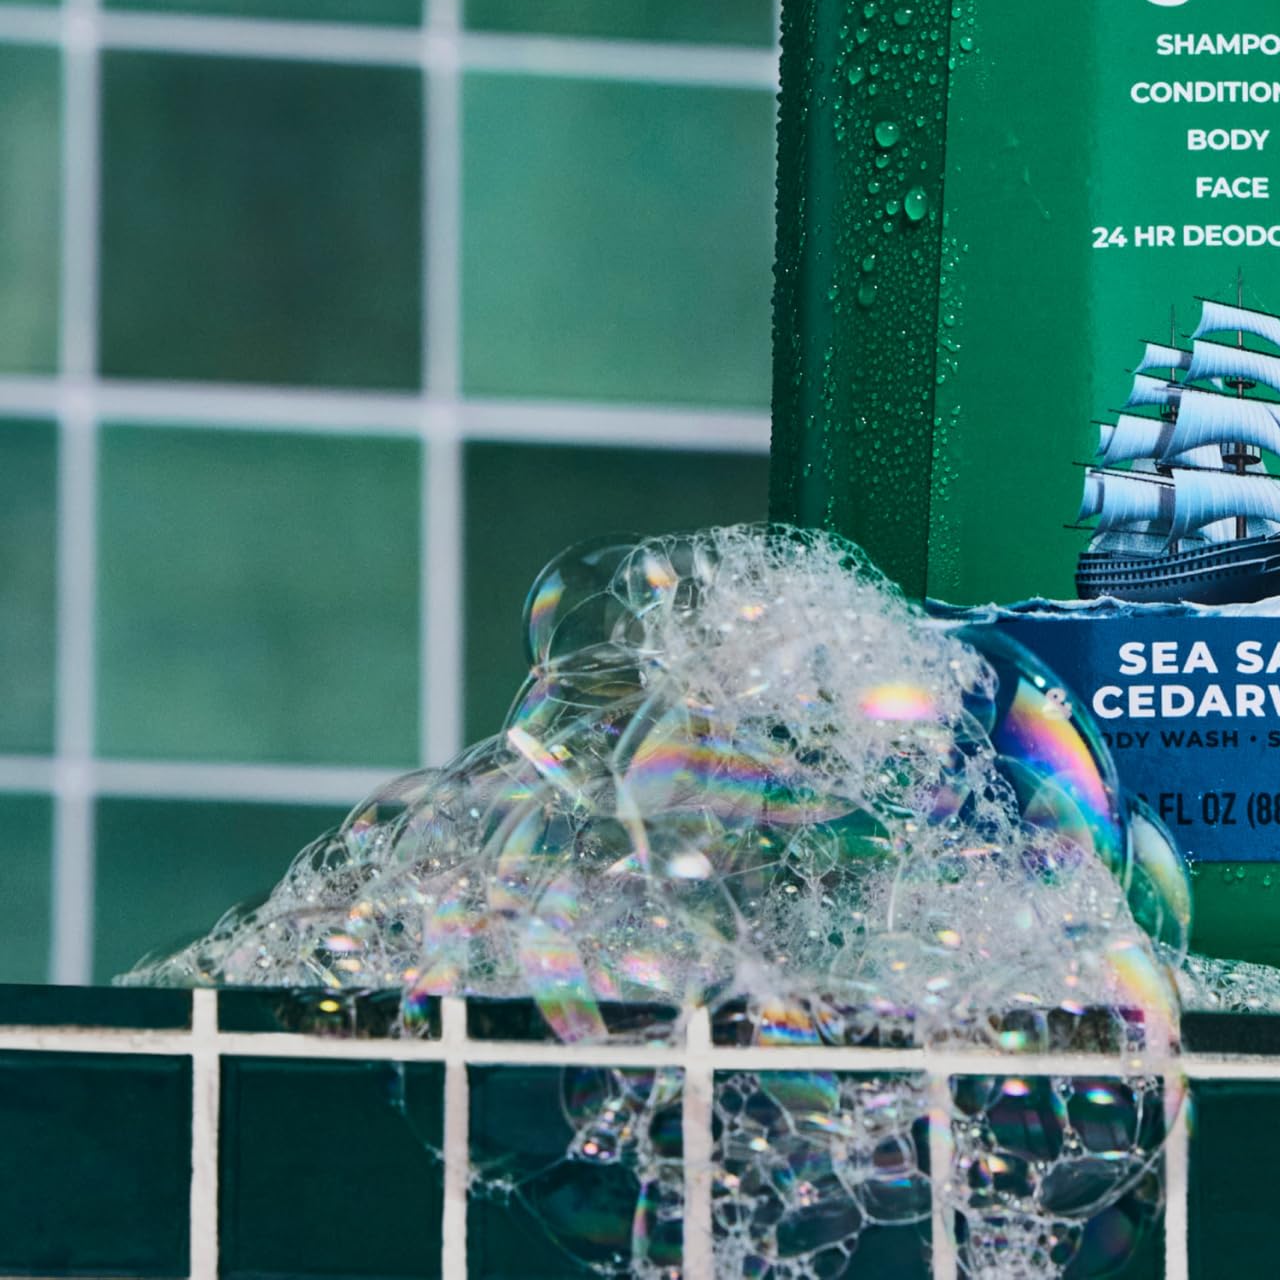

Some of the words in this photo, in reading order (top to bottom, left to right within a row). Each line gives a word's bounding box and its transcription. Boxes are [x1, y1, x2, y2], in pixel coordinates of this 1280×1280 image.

[1187, 128, 1270, 151] BODY
[1196, 176, 1269, 199] FACE
[1092, 226, 1128, 248] 24
[1134, 225, 1176, 247] HR
[1118, 641, 1219, 676] SEA
[1160, 730, 1239, 748] WASH
[1159, 792, 1193, 825] FL
[1202, 792, 1237, 825] OZ
